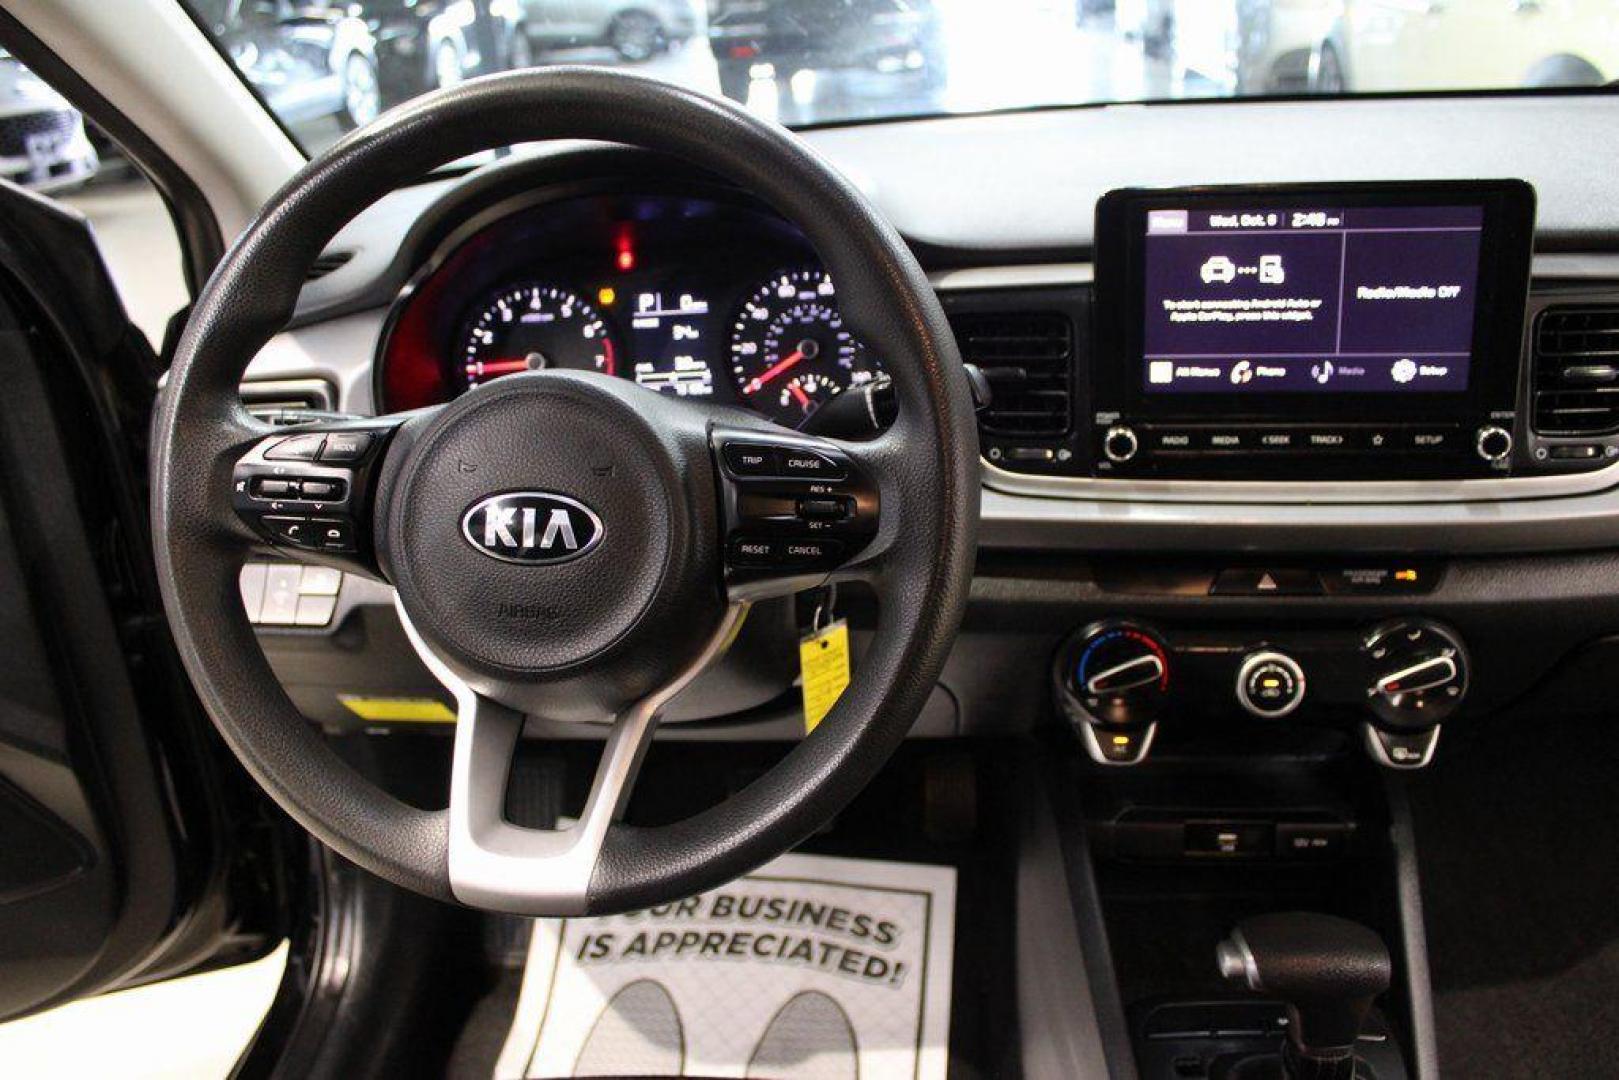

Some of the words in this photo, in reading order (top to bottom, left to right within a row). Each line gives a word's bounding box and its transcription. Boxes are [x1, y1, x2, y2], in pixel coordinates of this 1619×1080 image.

[1162, 435, 1189, 445] RADIO
[1211, 435, 1240, 445] MEDIA
[1414, 435, 1443, 444] SETUP
[742, 456, 763, 465] TRIP
[788, 459, 820, 469] CRUISE
[484, 505, 578, 550] KIA
[809, 521, 823, 529] SET
[741, 544, 770, 554] RESET
[788, 546, 823, 555] CANCEL
[710, 895, 897, 944] BUSINESS
[577, 932, 614, 961] IS
[622, 931, 904, 983] APPRECIATED!
